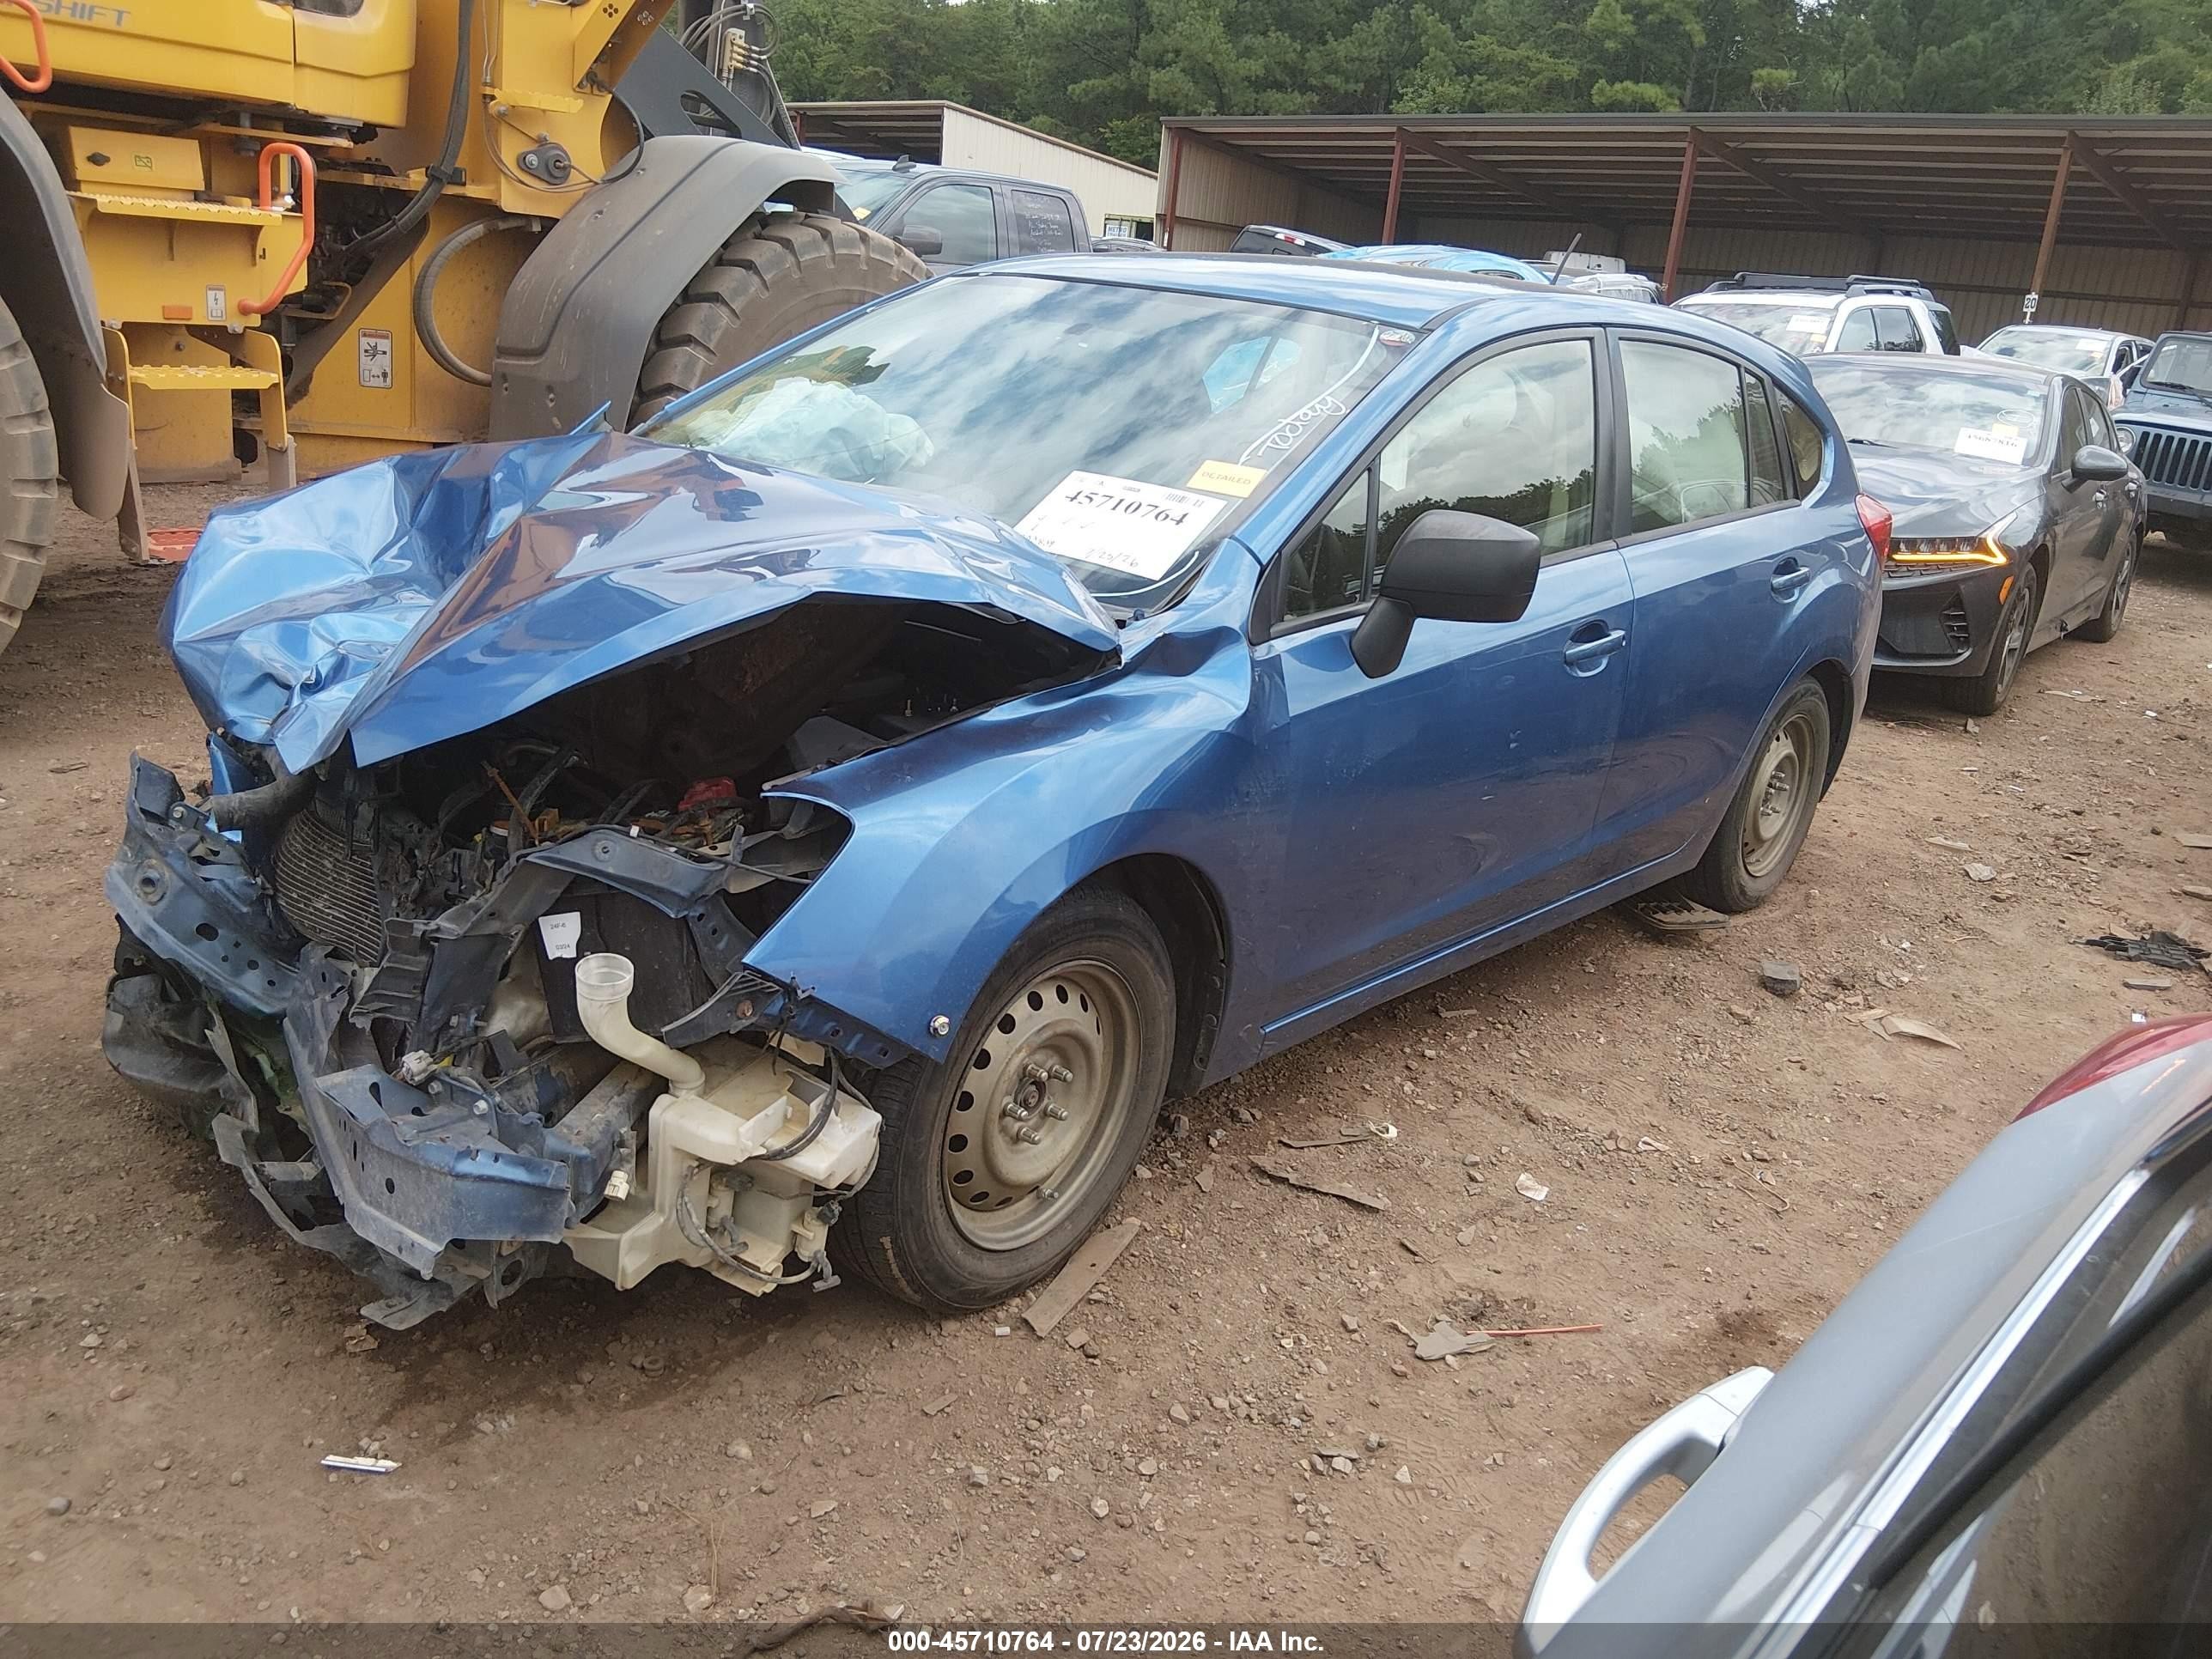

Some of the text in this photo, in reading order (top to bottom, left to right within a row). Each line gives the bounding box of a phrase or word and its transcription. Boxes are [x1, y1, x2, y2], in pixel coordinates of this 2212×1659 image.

[2024, 297, 2037, 309] 20
[1201, 471, 1252, 485] DETAILED
[1064, 489, 1189, 526] 45710764
